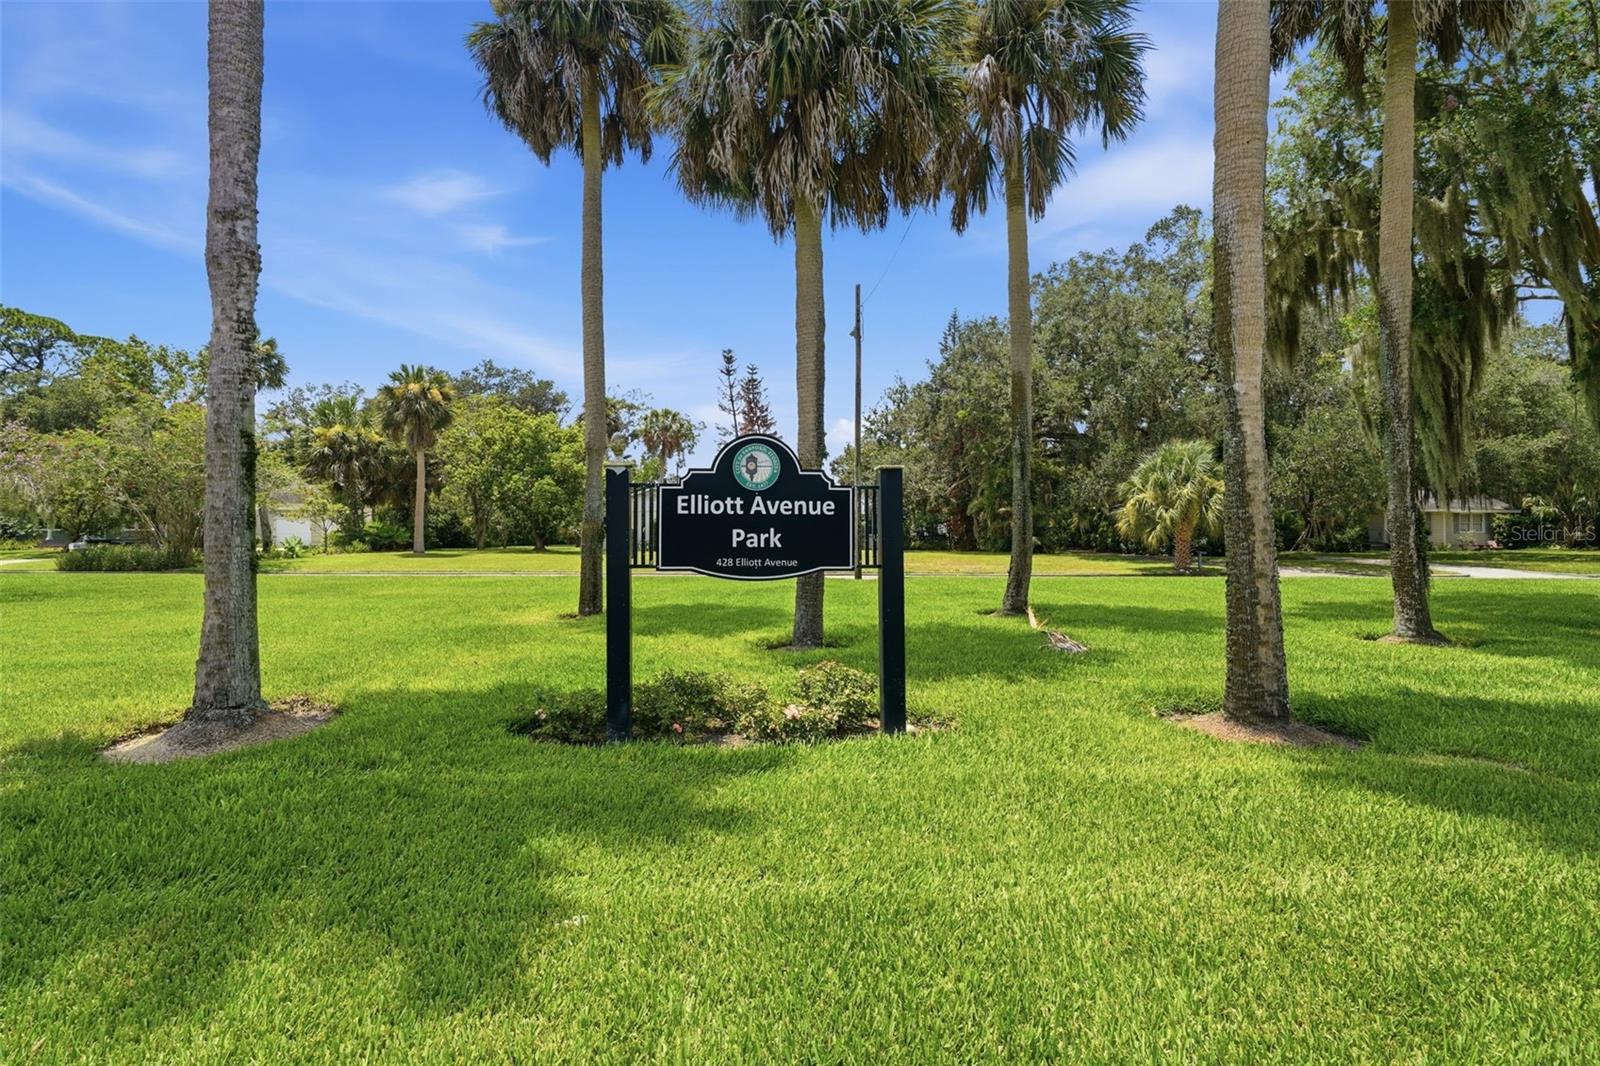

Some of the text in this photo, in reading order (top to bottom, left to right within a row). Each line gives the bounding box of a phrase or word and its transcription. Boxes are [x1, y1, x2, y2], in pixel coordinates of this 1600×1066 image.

[677, 494, 836, 515] Elliott Avenue
[732, 528, 782, 548] Park
[716, 557, 798, 567] 428 Elliott Avenue
